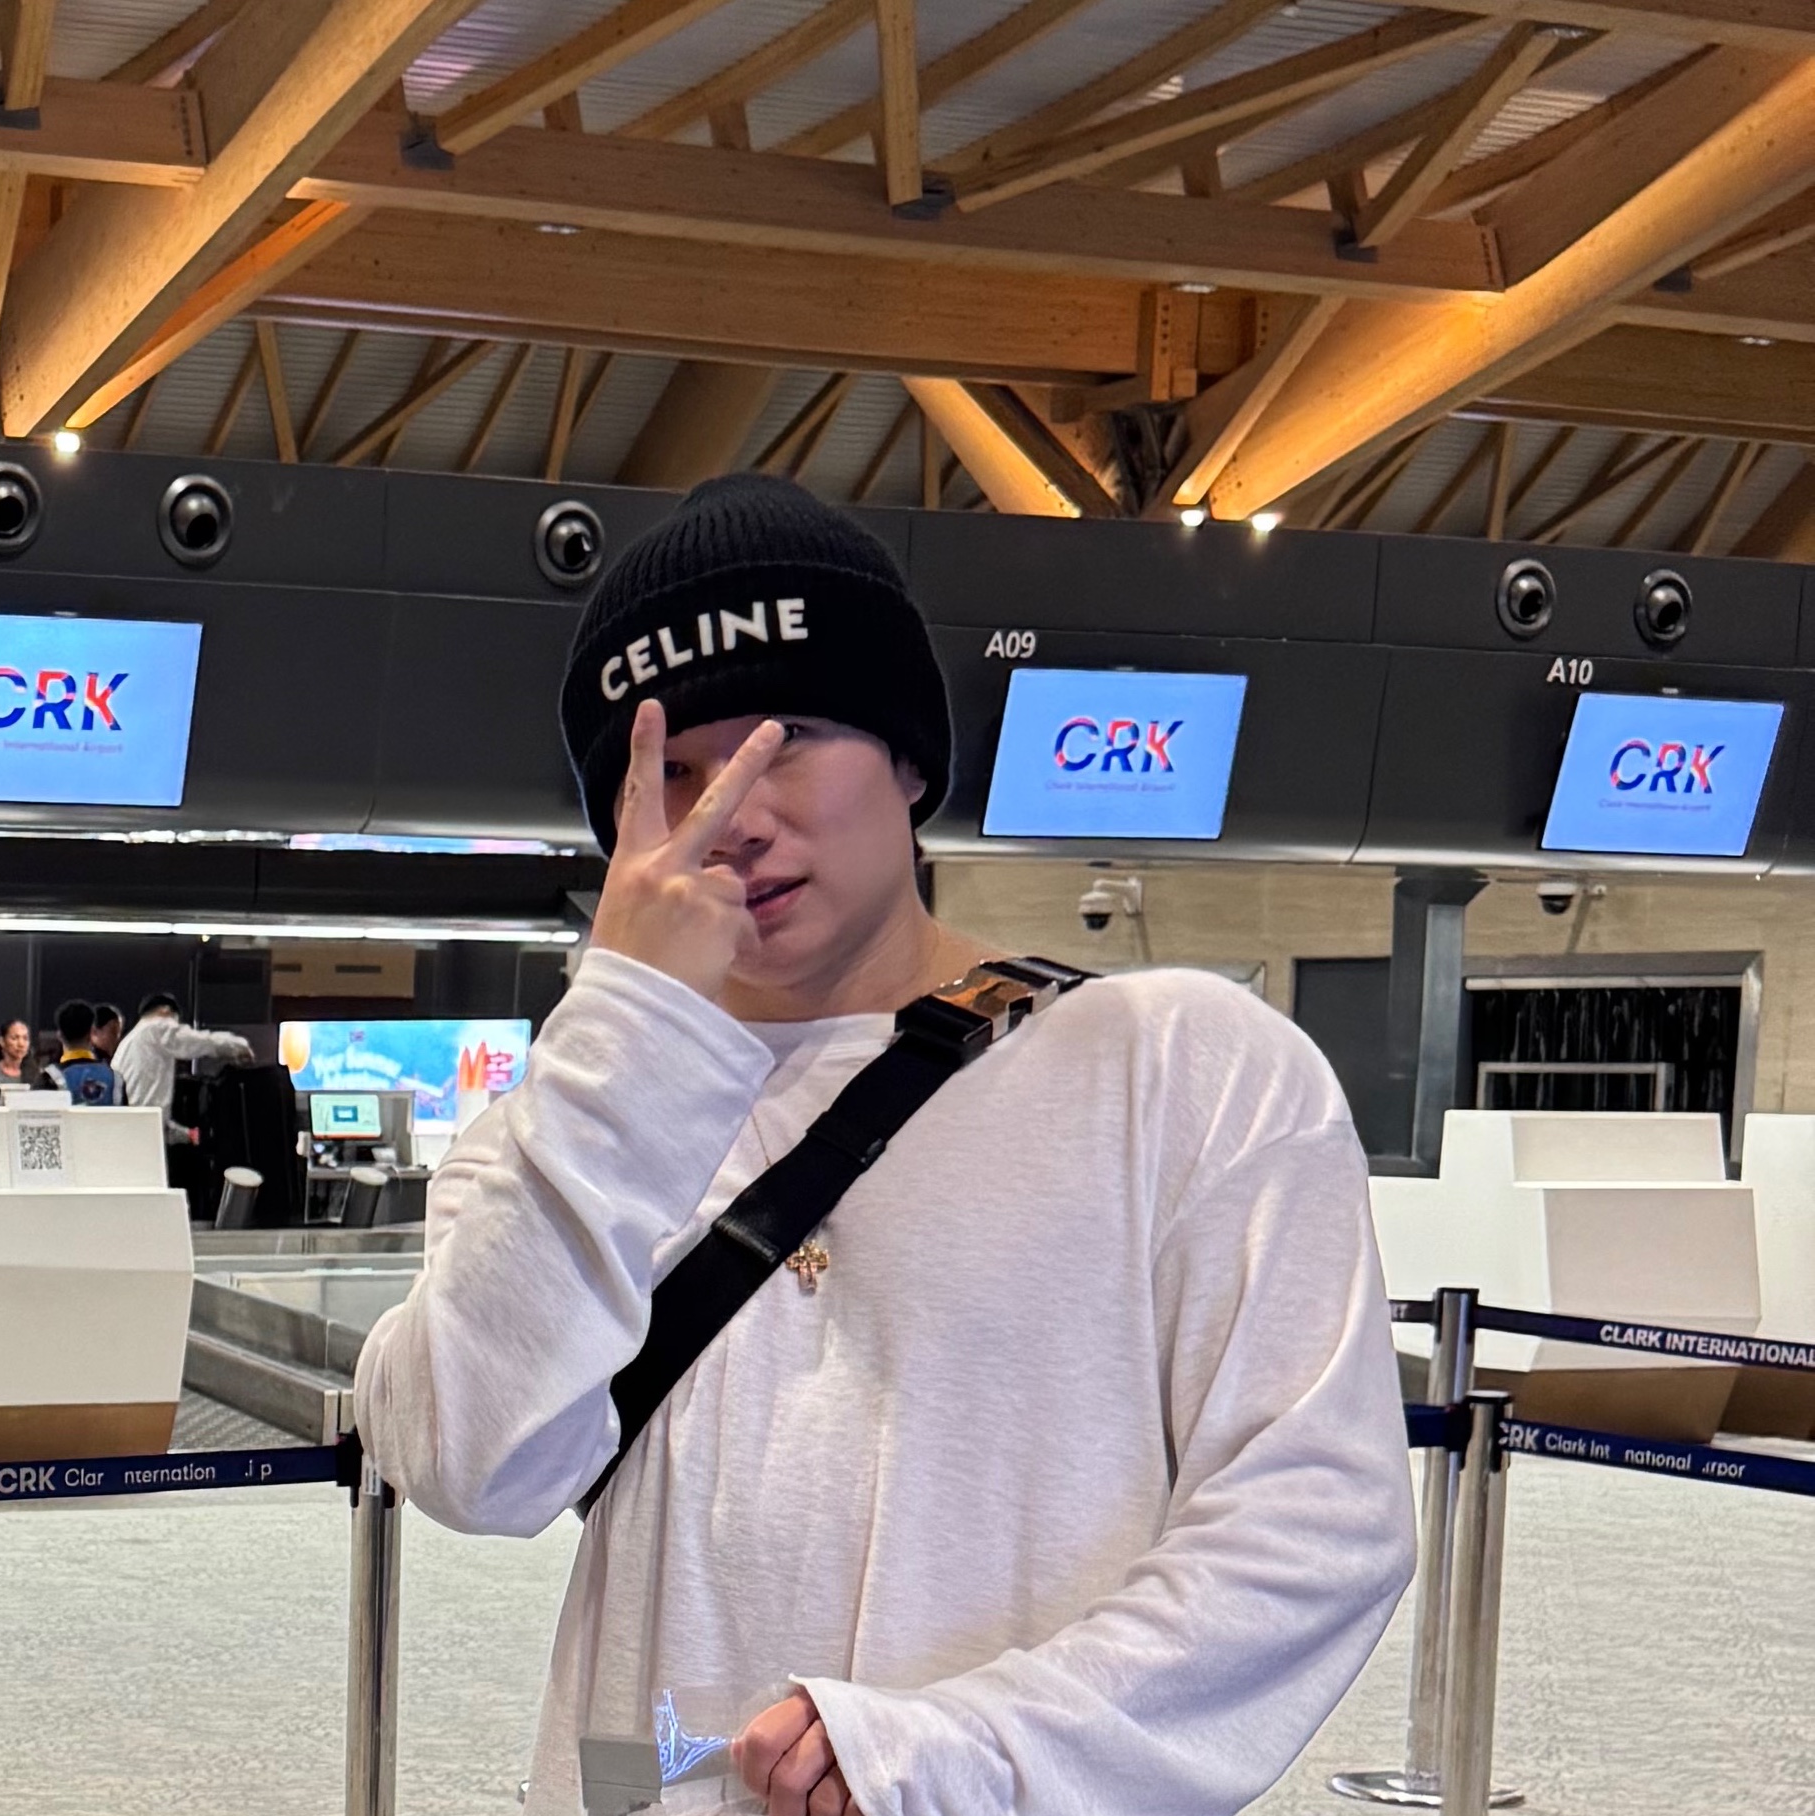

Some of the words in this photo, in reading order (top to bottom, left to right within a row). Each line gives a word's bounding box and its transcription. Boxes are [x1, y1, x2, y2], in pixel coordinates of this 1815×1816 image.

[600, 597, 810, 701] CELINE
[984, 631, 1037, 659] A09
[1546, 657, 1594, 685] A10
[1054, 716, 1185, 773] CRK
[1609, 738, 1726, 794] CRK
[1599, 1324, 1663, 1349] CLARK
[1665, 1331, 1815, 1367] INTERNATIONAL
[1544, 1431, 1586, 1455] Clark
[64, 1468, 104, 1488] Clar
[124, 1462, 216, 1485] nternation
